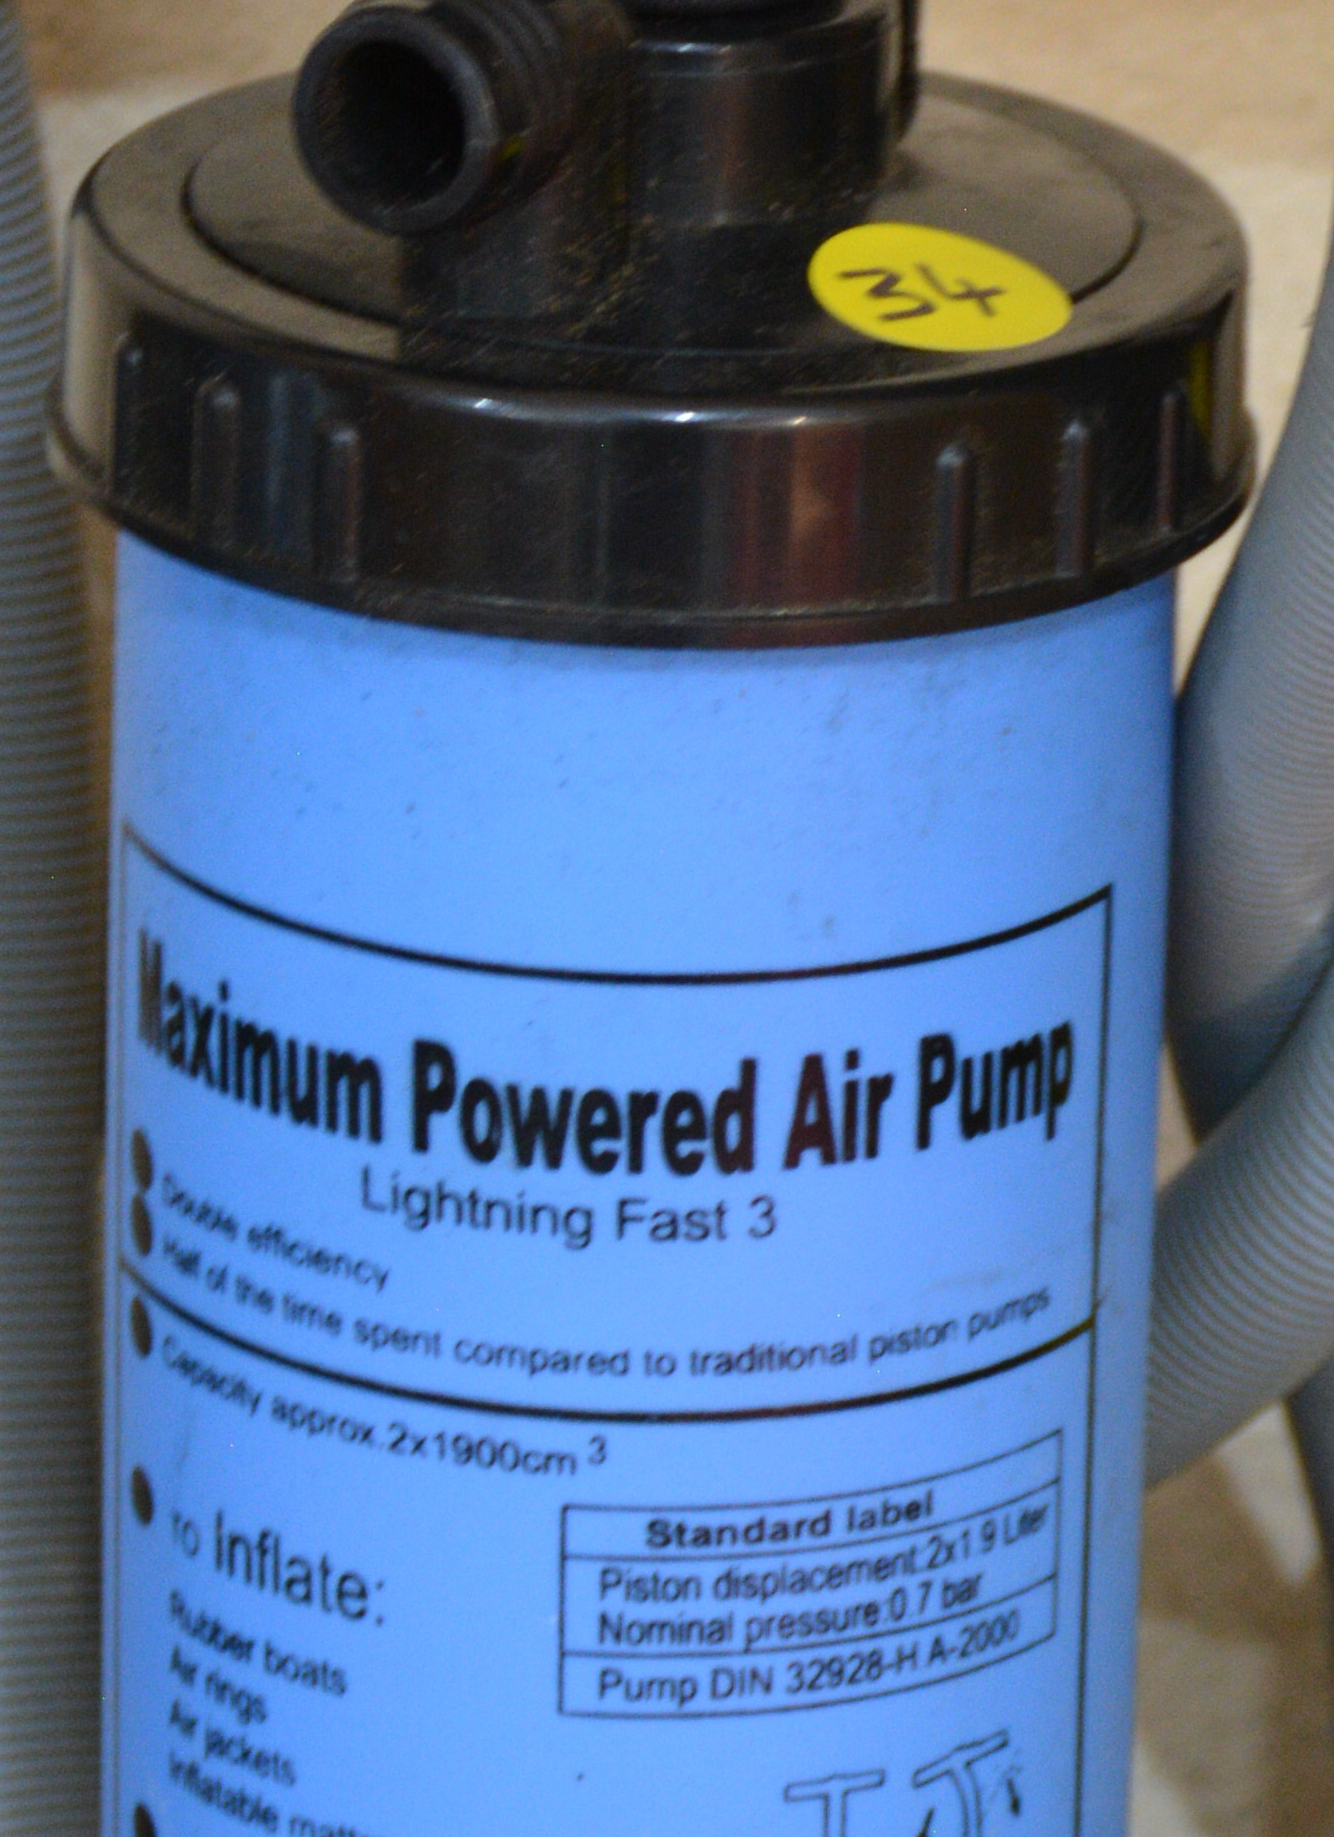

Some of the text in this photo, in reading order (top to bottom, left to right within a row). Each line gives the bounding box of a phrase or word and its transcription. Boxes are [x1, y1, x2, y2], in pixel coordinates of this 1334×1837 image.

[837, 263, 1007, 322] 34
[138, 926, 1074, 1176] Maximum Powered Air Pump
[361, 1164, 778, 1250] Lightning Fast 3
[247, 1223, 389, 1293] efficiency
[353, 1314, 442, 1358] spent
[454, 1337, 630, 1380] compared
[644, 1346, 676, 1377] to
[689, 1334, 858, 1376] traditional
[869, 1318, 959, 1364] piston
[969, 1286, 1050, 1338] pumps
[646, 1489, 934, 1549] Standard label
[599, 1568, 700, 1603] Piston
[599, 1612, 733, 1648] Nominal
[263, 1639, 348, 1696] boats
[599, 1669, 698, 1706] Pump
[710, 1664, 773, 1699] DIN
